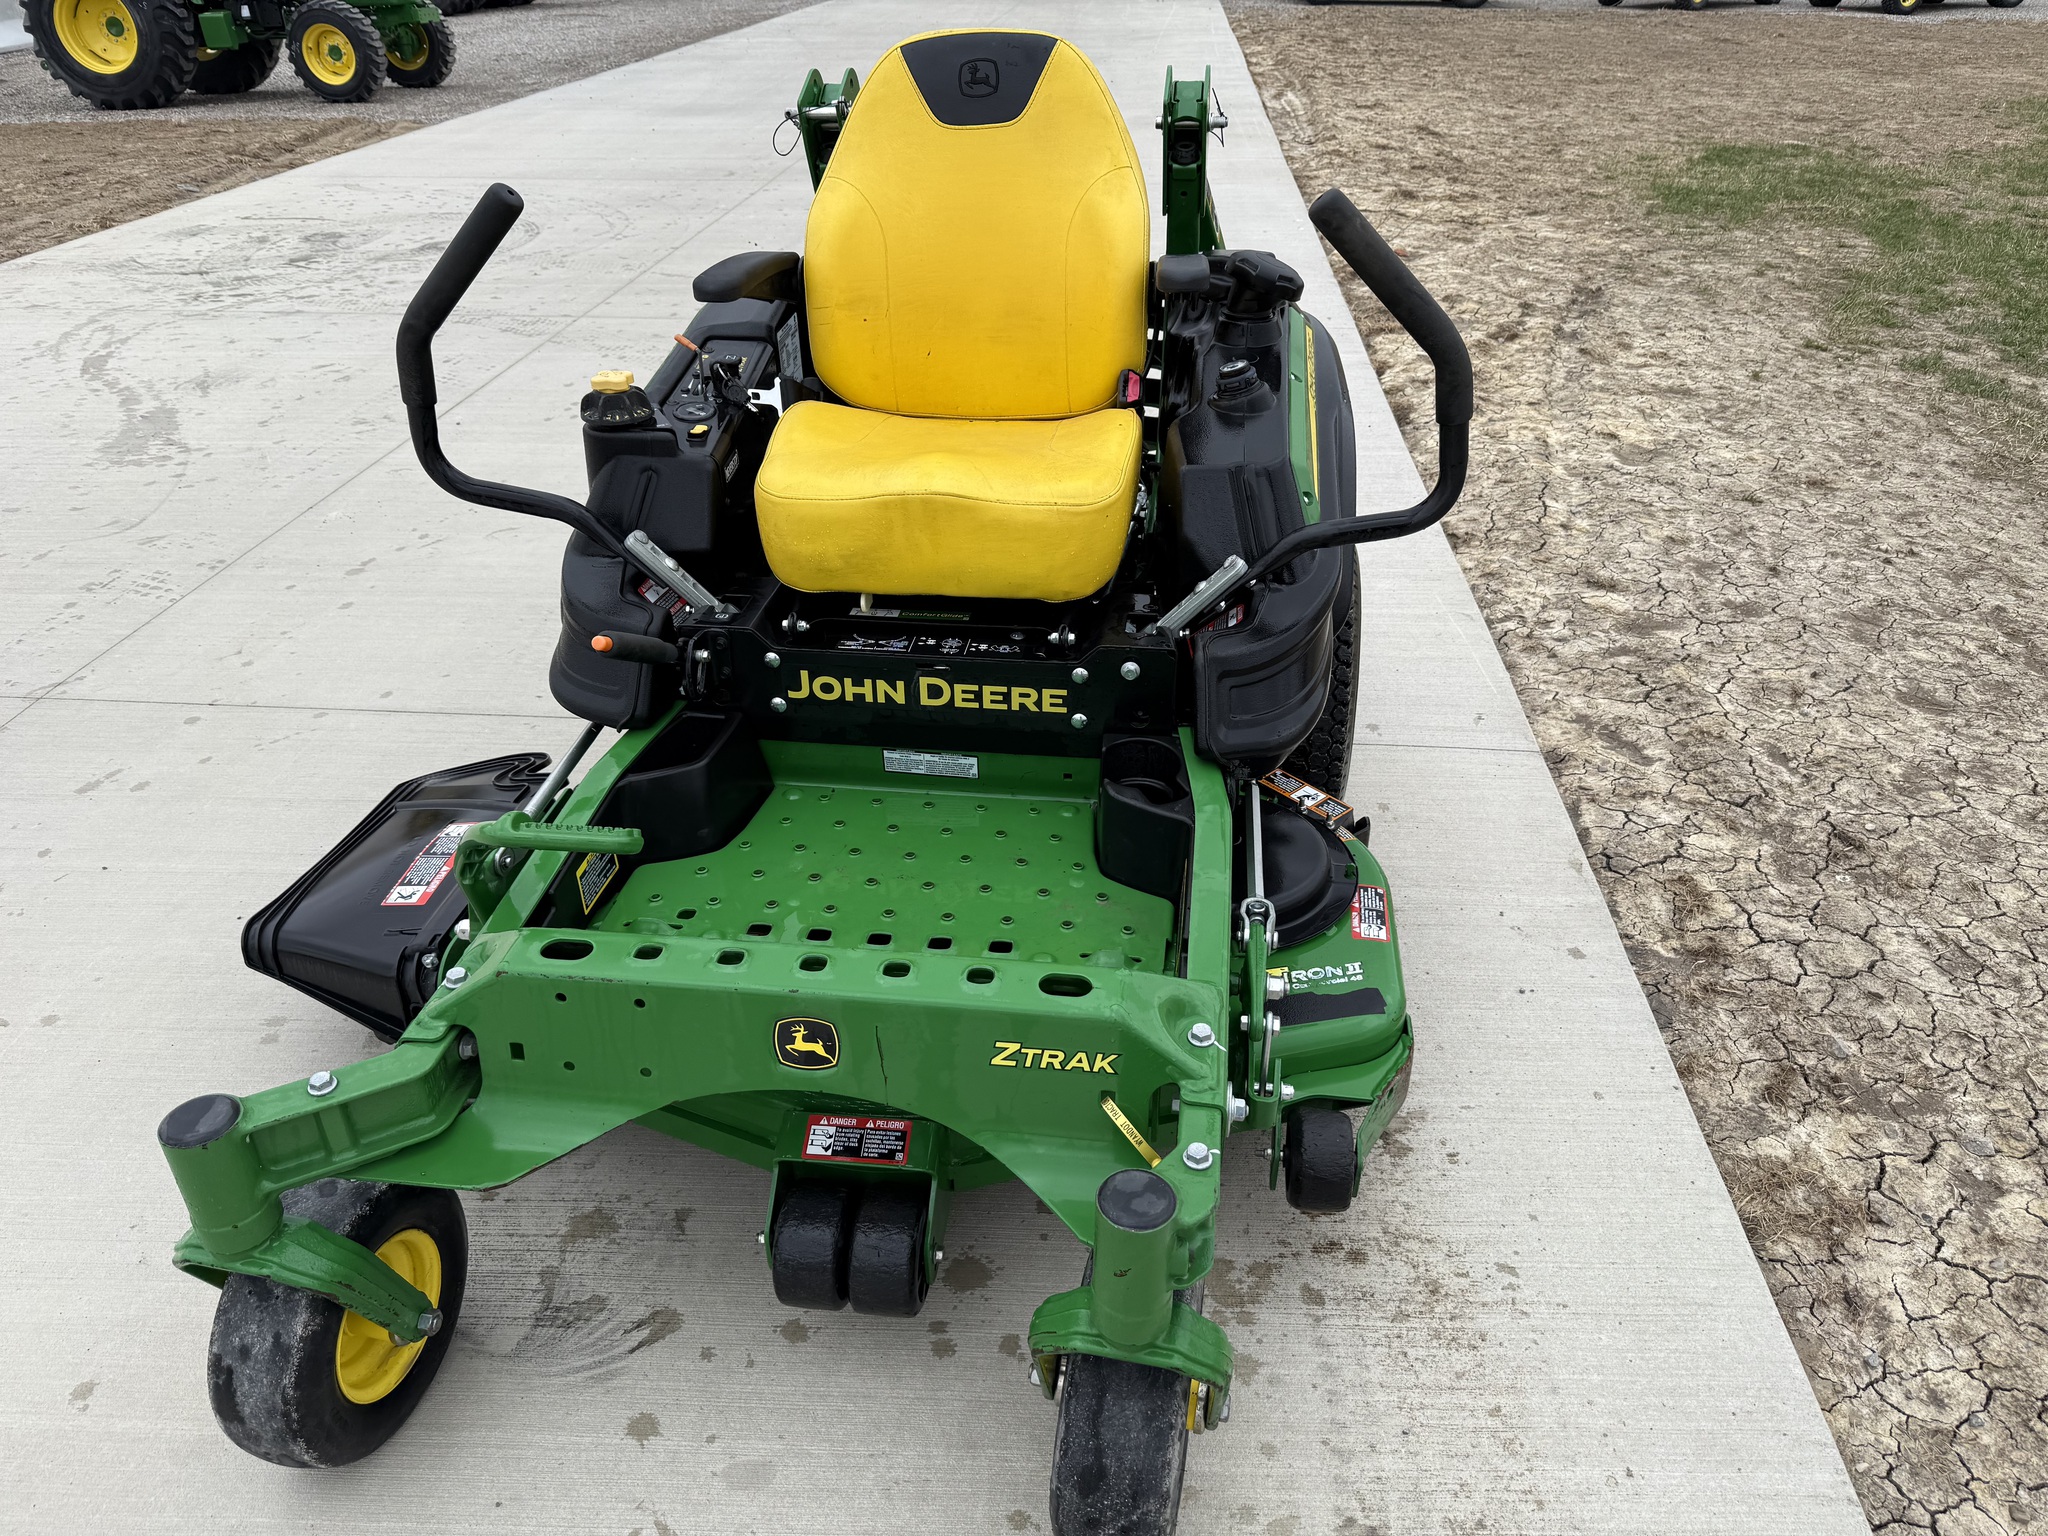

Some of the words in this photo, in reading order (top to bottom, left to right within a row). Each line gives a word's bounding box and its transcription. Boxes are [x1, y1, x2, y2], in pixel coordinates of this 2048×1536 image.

[787, 669, 906, 705] JOHN
[918, 676, 1068, 714] DEERE
[990, 1040, 1120, 1075] ZTRAK
[876, 1121, 904, 1129] PELIGRO
